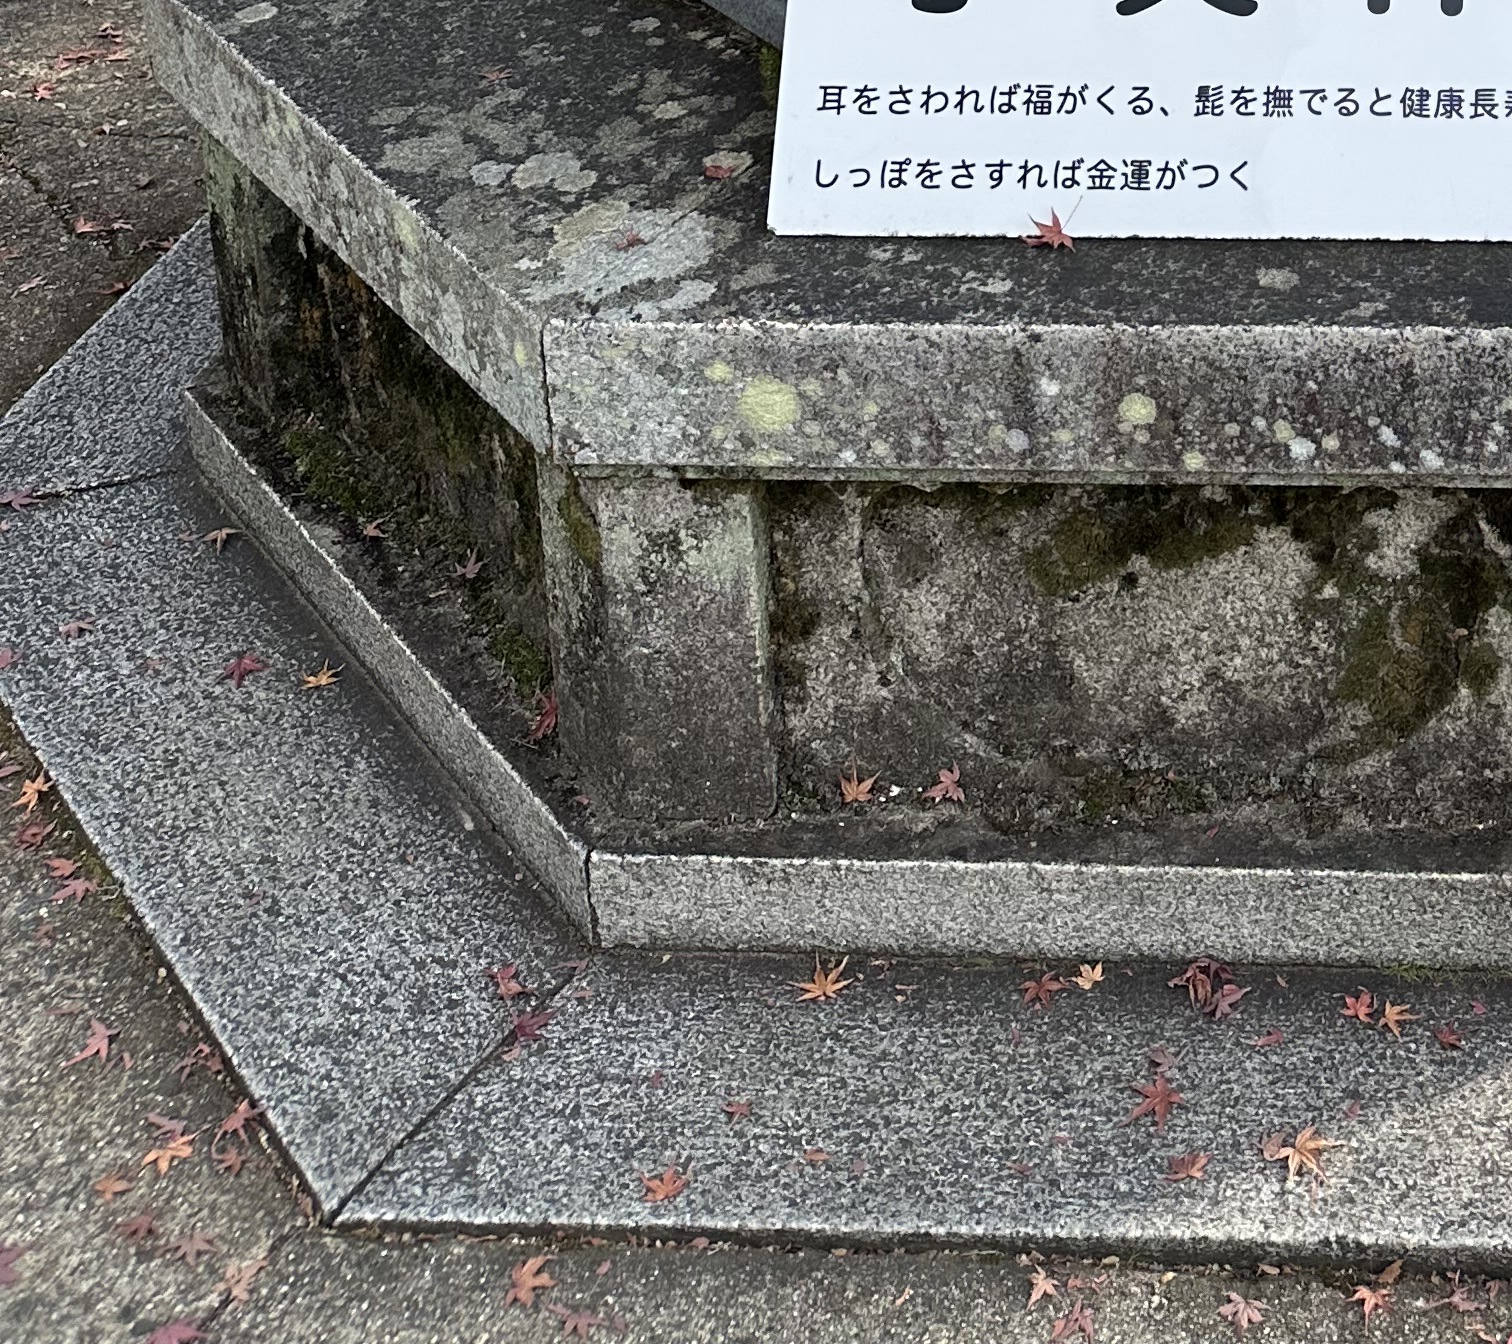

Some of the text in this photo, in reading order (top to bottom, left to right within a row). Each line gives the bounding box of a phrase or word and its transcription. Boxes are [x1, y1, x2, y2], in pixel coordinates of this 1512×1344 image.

[814, 156, 1250, 192] しっぽをさすれば金運がつく
